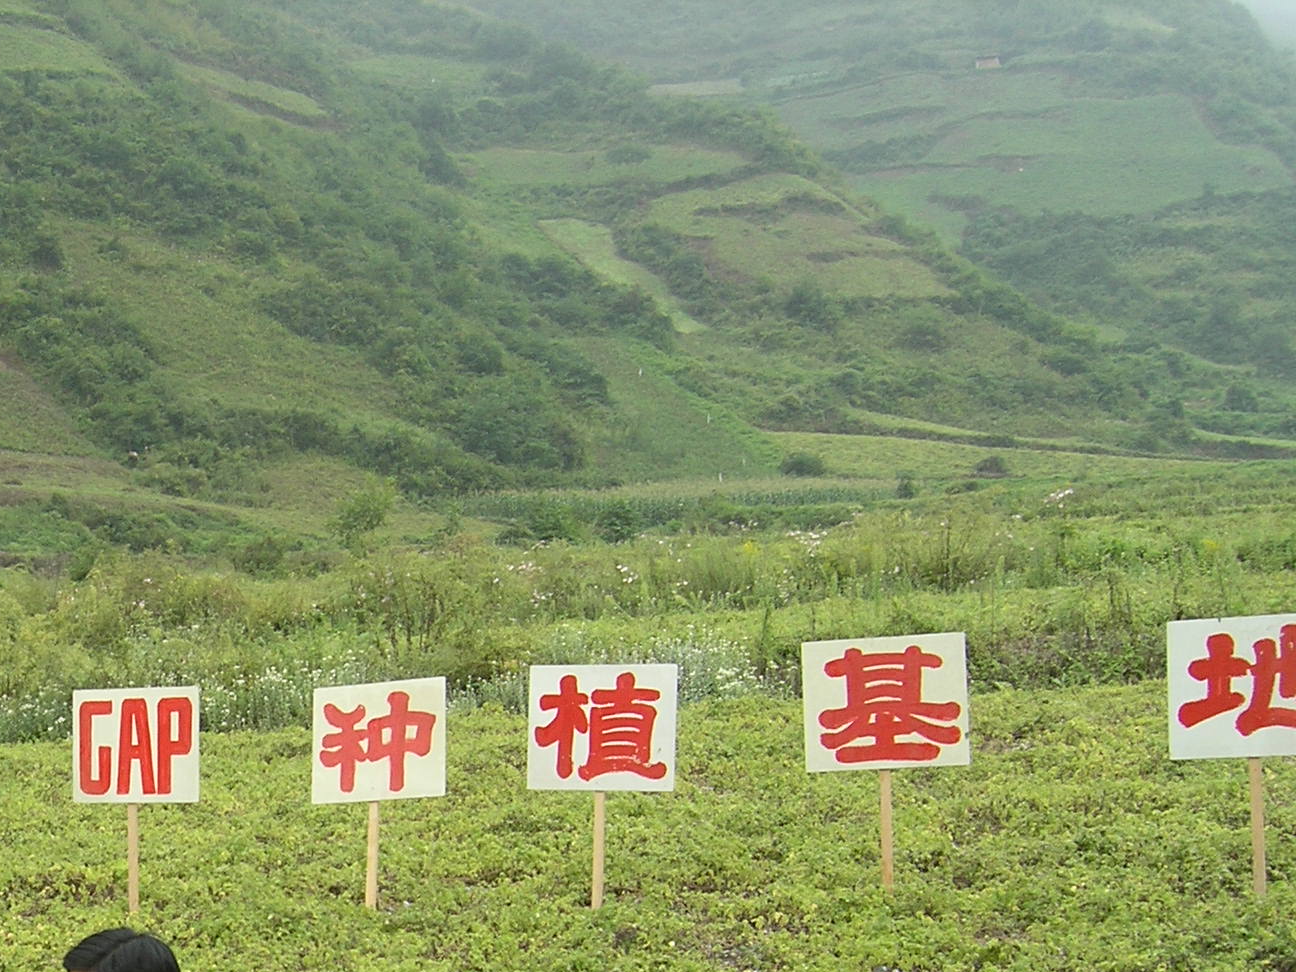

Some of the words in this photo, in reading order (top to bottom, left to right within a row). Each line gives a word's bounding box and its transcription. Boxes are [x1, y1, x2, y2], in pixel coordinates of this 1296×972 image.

[535, 673, 666, 781] 植
[818, 646, 960, 764] 基
[1178, 624, 1296, 736] 地
[79, 698, 192, 795] GAP
[320, 692, 436, 792] 种
